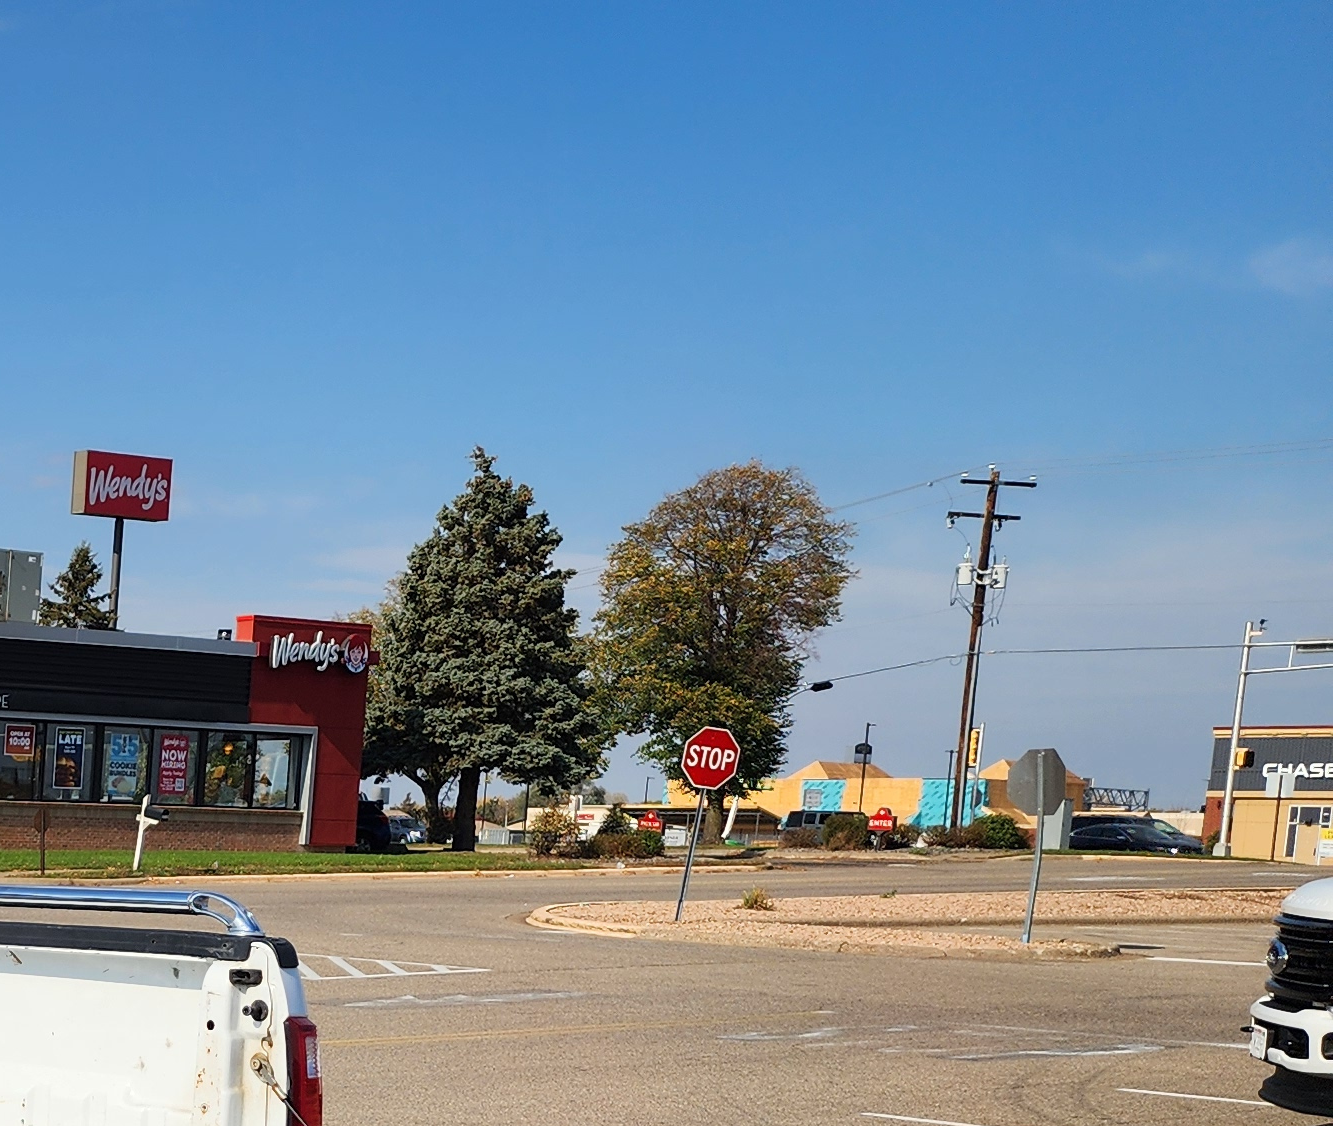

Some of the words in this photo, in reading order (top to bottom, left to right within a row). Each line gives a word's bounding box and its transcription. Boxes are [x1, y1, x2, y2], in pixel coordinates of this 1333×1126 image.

[89, 464, 168, 510] Wendy's
[270, 631, 339, 671] Wendy's
[9, 737, 31, 746] 10:00
[59, 734, 82, 745] LATE
[162, 749, 187, 761] NOW
[686, 744, 735, 770] STOP
[110, 762, 137, 770] COOKIE
[161, 760, 186, 769] HIRING
[1262, 763, 1333, 778] CHASE
[869, 819, 892, 827] ENTER
